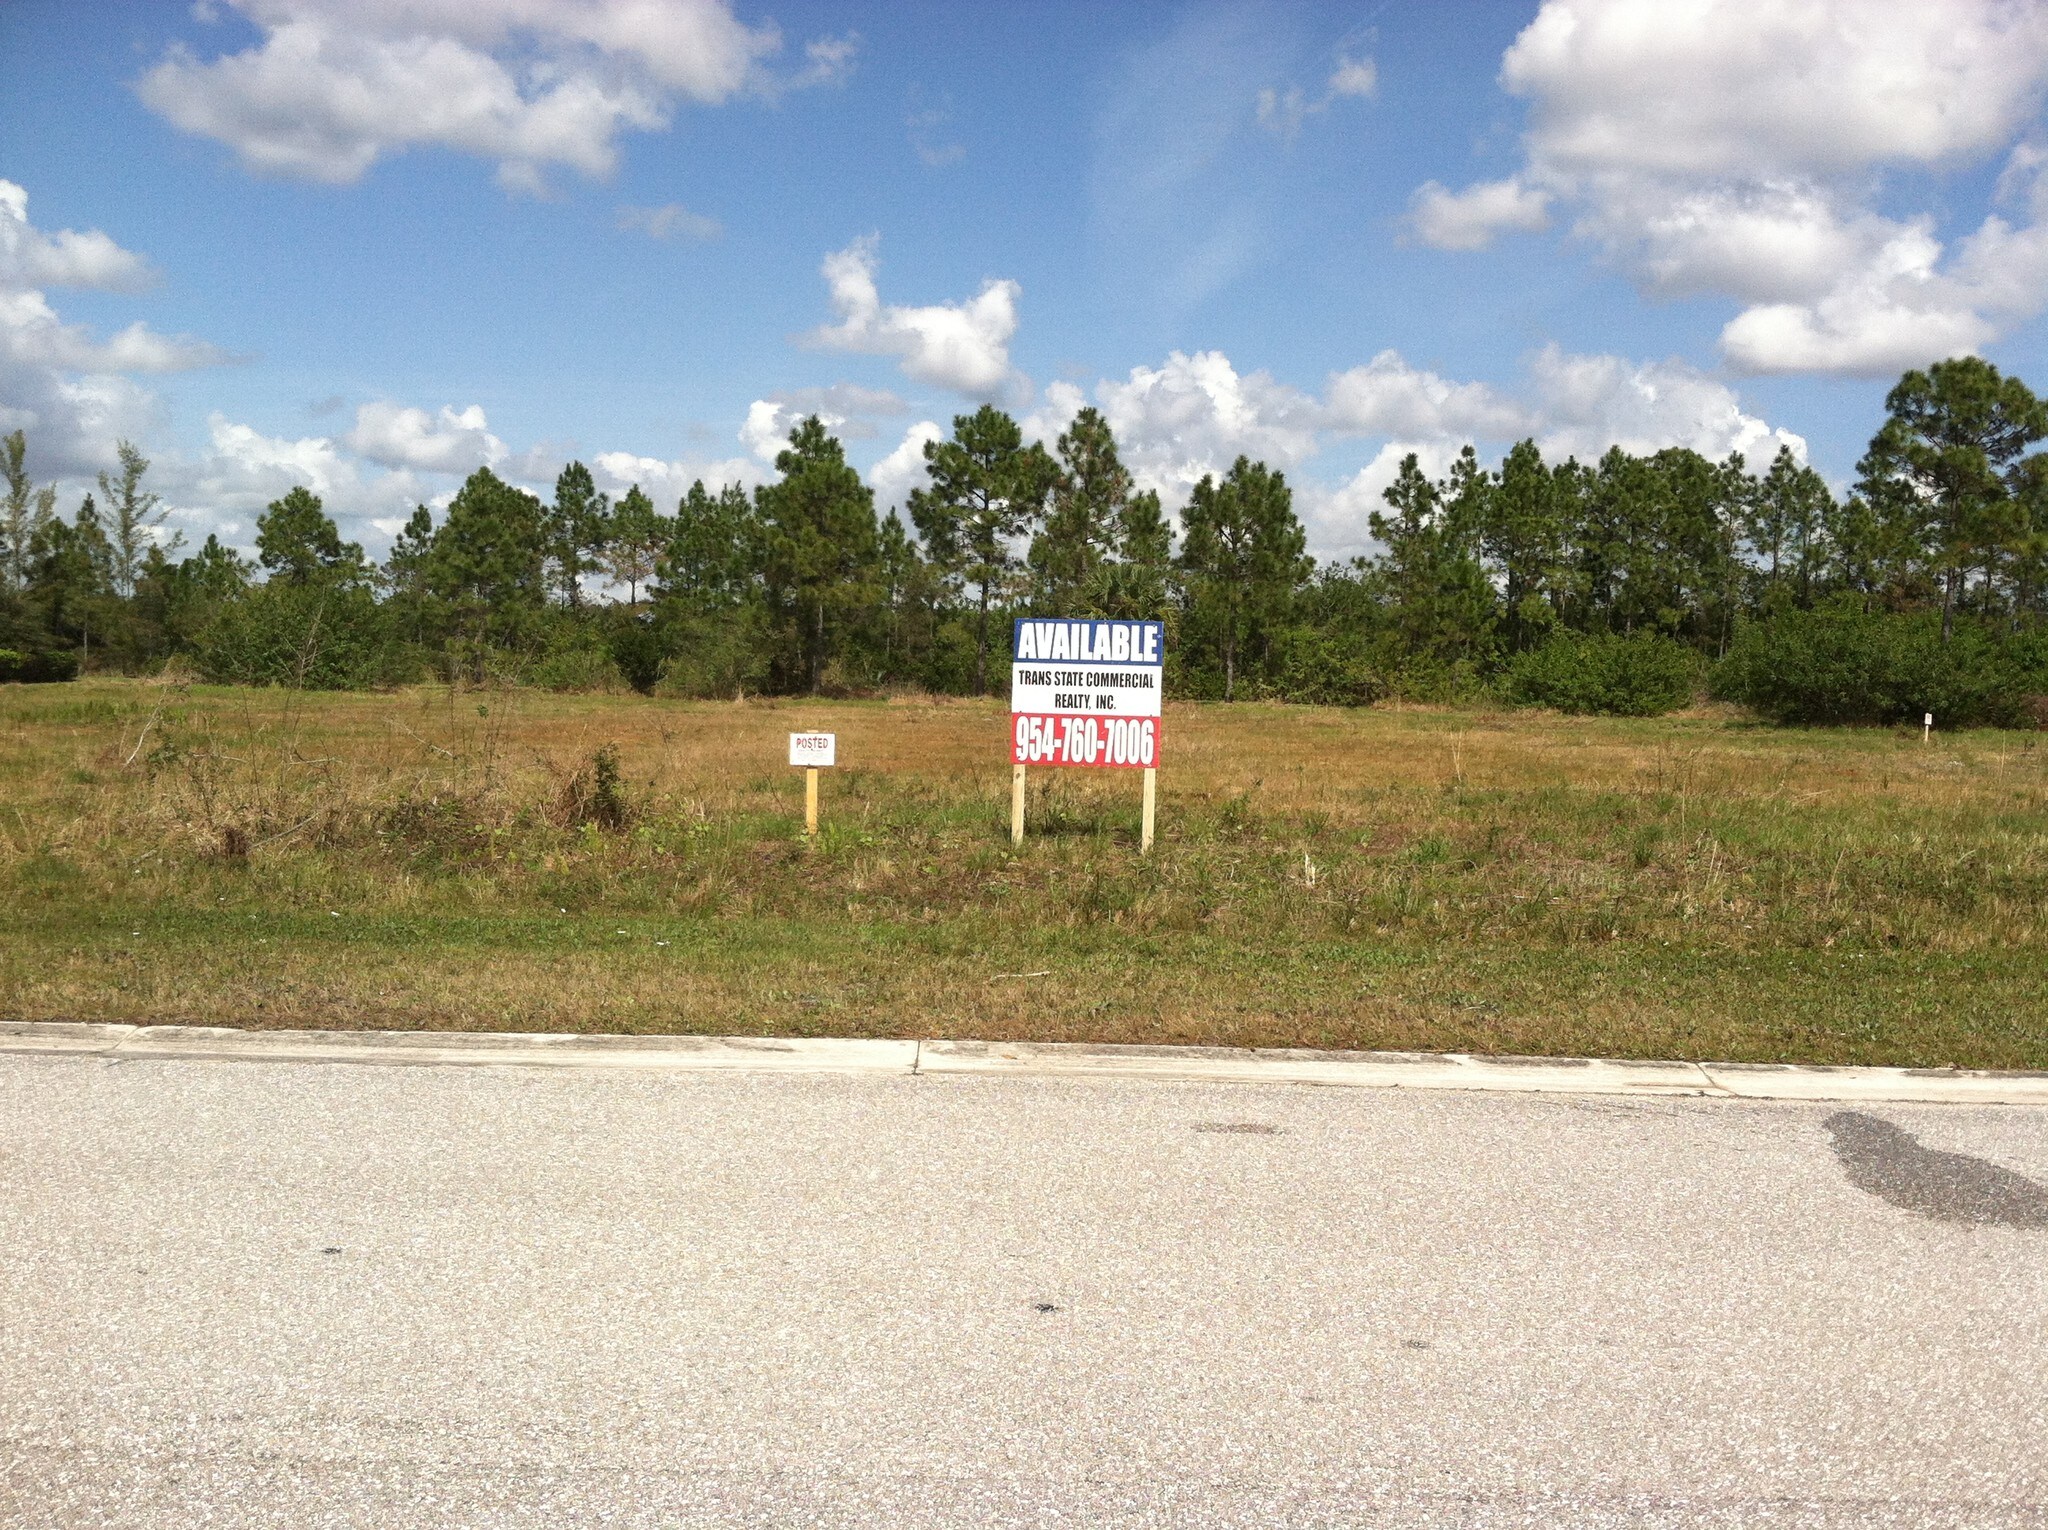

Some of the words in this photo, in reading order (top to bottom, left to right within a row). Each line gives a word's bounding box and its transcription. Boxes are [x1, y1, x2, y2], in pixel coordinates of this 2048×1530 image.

[1017, 622, 1158, 662] AVAILABLE
[1018, 670, 1052, 686] TRANS
[1054, 671, 1084, 687] STATE
[1086, 672, 1154, 689] COMMERCIAL
[1054, 693, 1092, 711] REALTY,
[1096, 694, 1117, 710] INC.
[796, 737, 829, 749] POSTED
[1016, 715, 1155, 765] 954-760-7006
